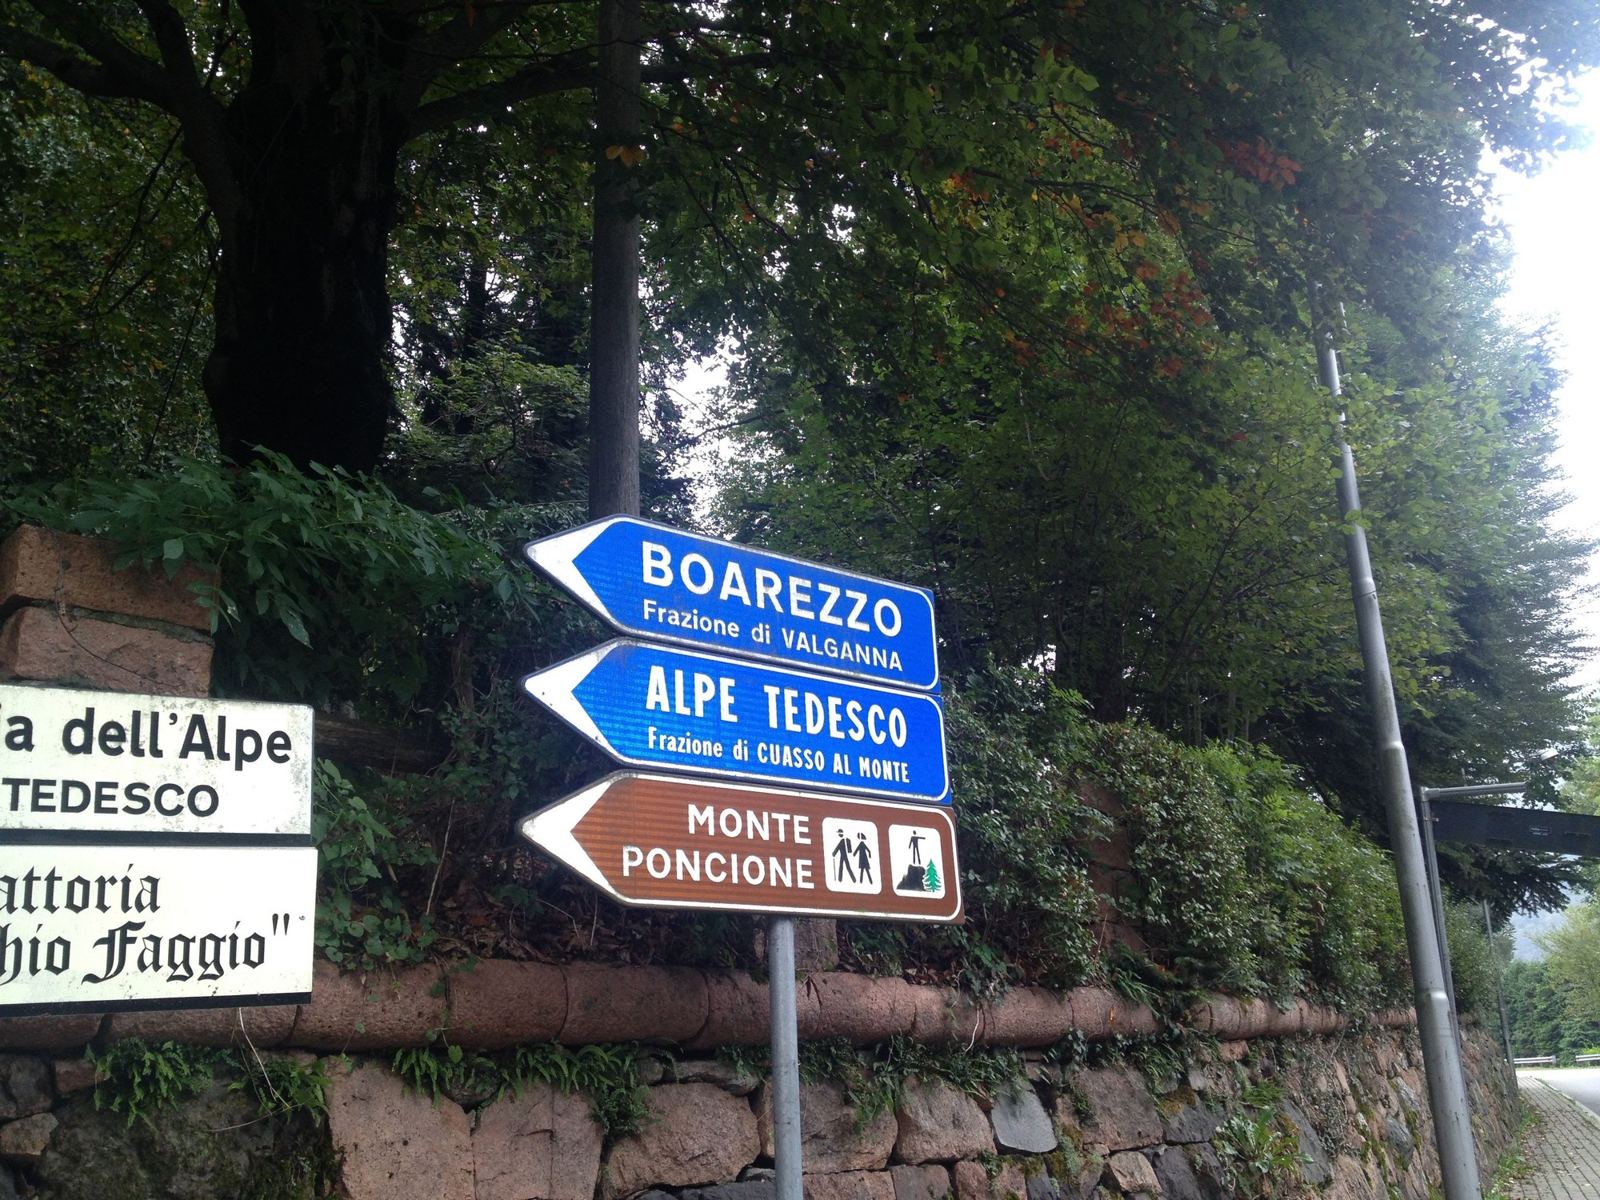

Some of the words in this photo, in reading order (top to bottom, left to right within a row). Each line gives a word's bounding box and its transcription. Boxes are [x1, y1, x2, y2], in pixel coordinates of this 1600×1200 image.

[641, 541, 902, 637] BOAREZZO
[642, 599, 740, 638] Frazione
[751, 623, 771, 645] di
[781, 628, 903, 672] VALGANNA
[645, 665, 738, 723] ALPE
[763, 685, 907, 748] TEDESCO
[648, 726, 723, 758] Frazione
[733, 738, 749, 762] di
[757, 743, 825, 771] CUASSO
[833, 753, 852, 775] AL
[858, 756, 910, 783] MONTE
[2, 777, 219, 818] TEDESCO
[687, 804, 812, 845] MONTE
[622, 846, 815, 889] PONCIONE
